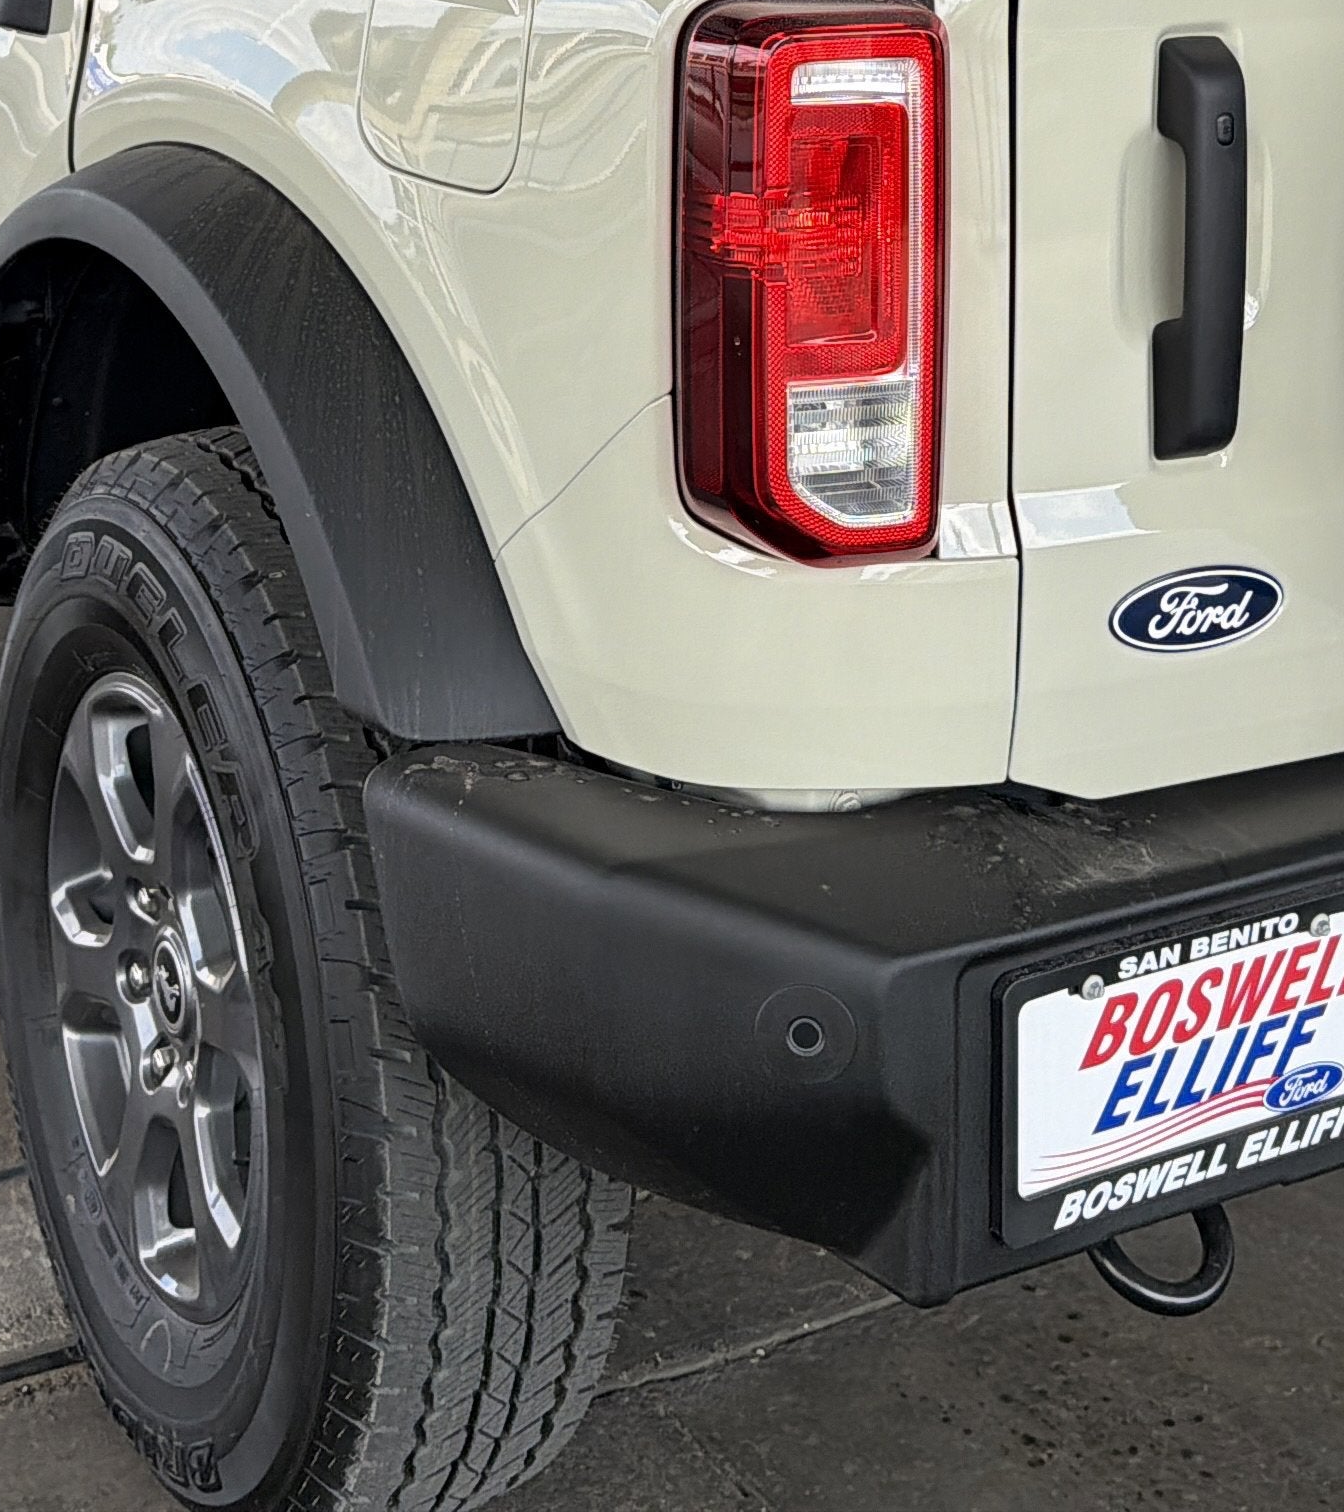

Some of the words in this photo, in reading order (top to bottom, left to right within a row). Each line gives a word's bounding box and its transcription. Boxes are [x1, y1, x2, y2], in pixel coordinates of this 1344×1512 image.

[1147, 582, 1254, 640] Ford
[59, 530, 260, 863] DUELER
[1117, 943, 1181, 980] SAN
[1189, 912, 1299, 960] BENITO
[1092, 1002, 1329, 1135] ELLIFF
[1279, 1069, 1329, 1105] Ford
[1053, 1143, 1229, 1230] BOSWELL
